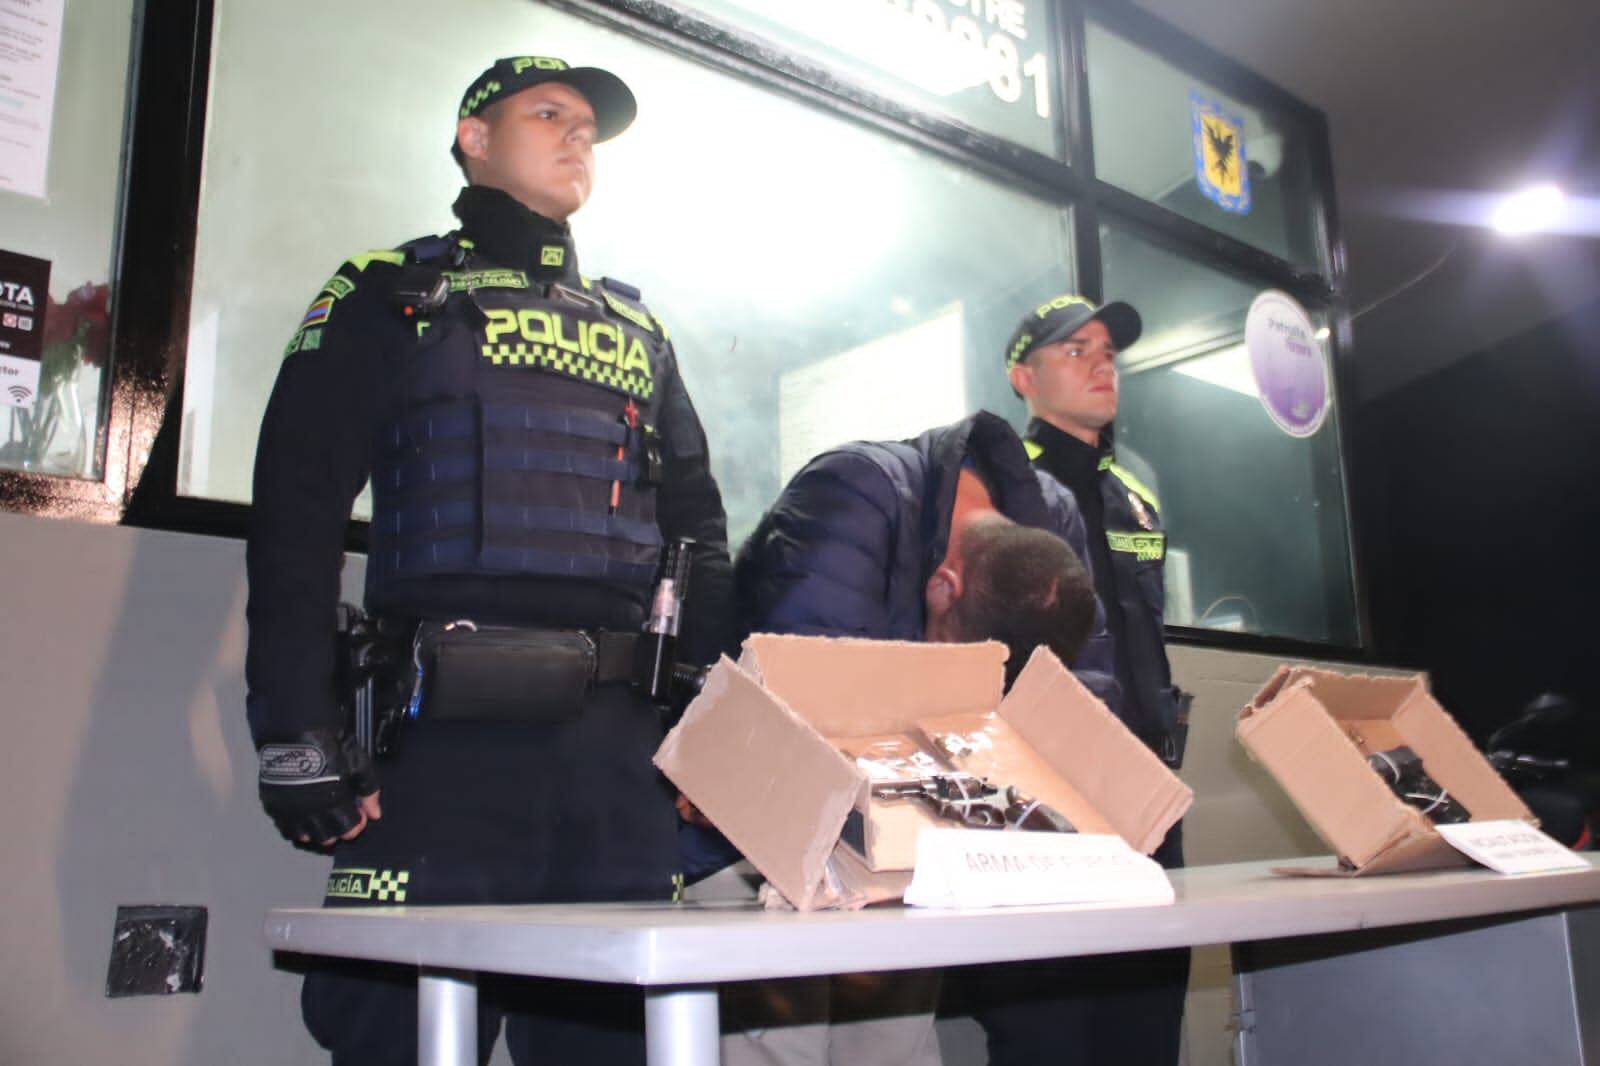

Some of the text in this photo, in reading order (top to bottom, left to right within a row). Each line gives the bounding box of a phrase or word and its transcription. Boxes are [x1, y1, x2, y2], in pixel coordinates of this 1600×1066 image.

[0, 281, 34, 305] TA
[484, 308, 650, 378] POLICÍA
[965, 852, 1026, 873] ARMA
